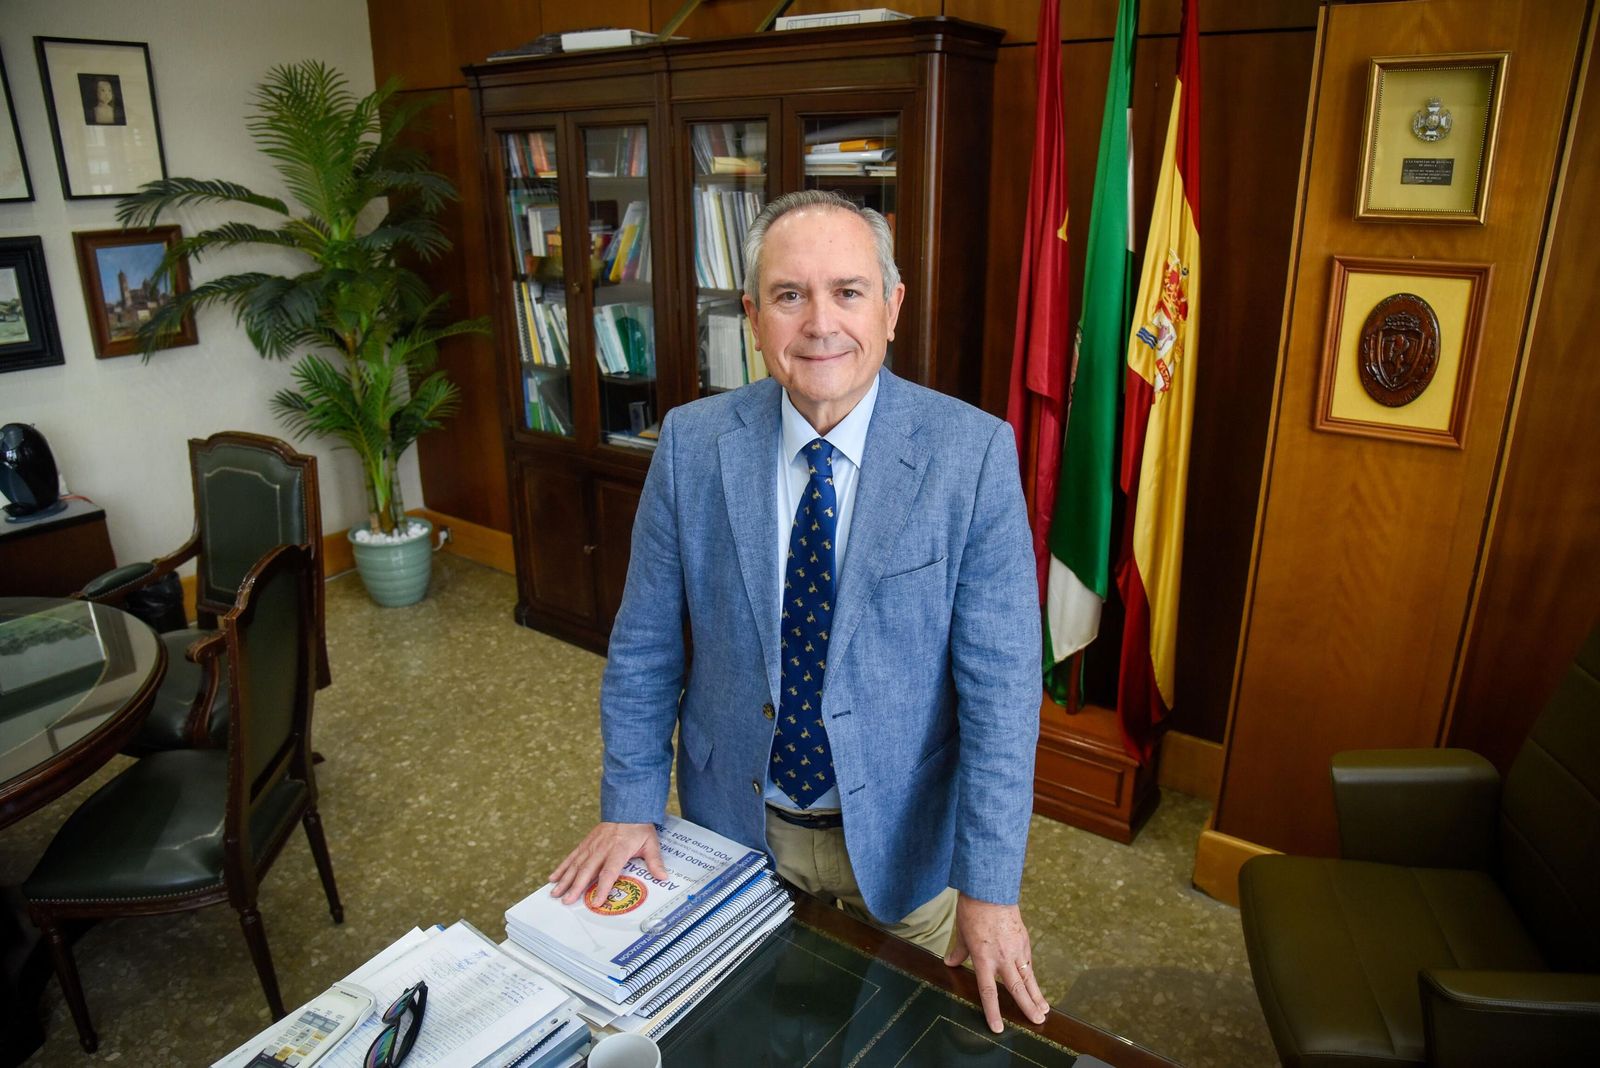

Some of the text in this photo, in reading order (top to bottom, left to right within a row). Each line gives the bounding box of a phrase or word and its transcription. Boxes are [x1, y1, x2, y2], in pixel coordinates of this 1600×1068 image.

[671, 832, 692, 844] 2024
[692, 840, 714, 854] Curso
[673, 849, 686, 859] EN
[714, 851, 733, 862] POD
[685, 855, 716, 872] GRADO
[623, 861, 680, 891] APROBAD
